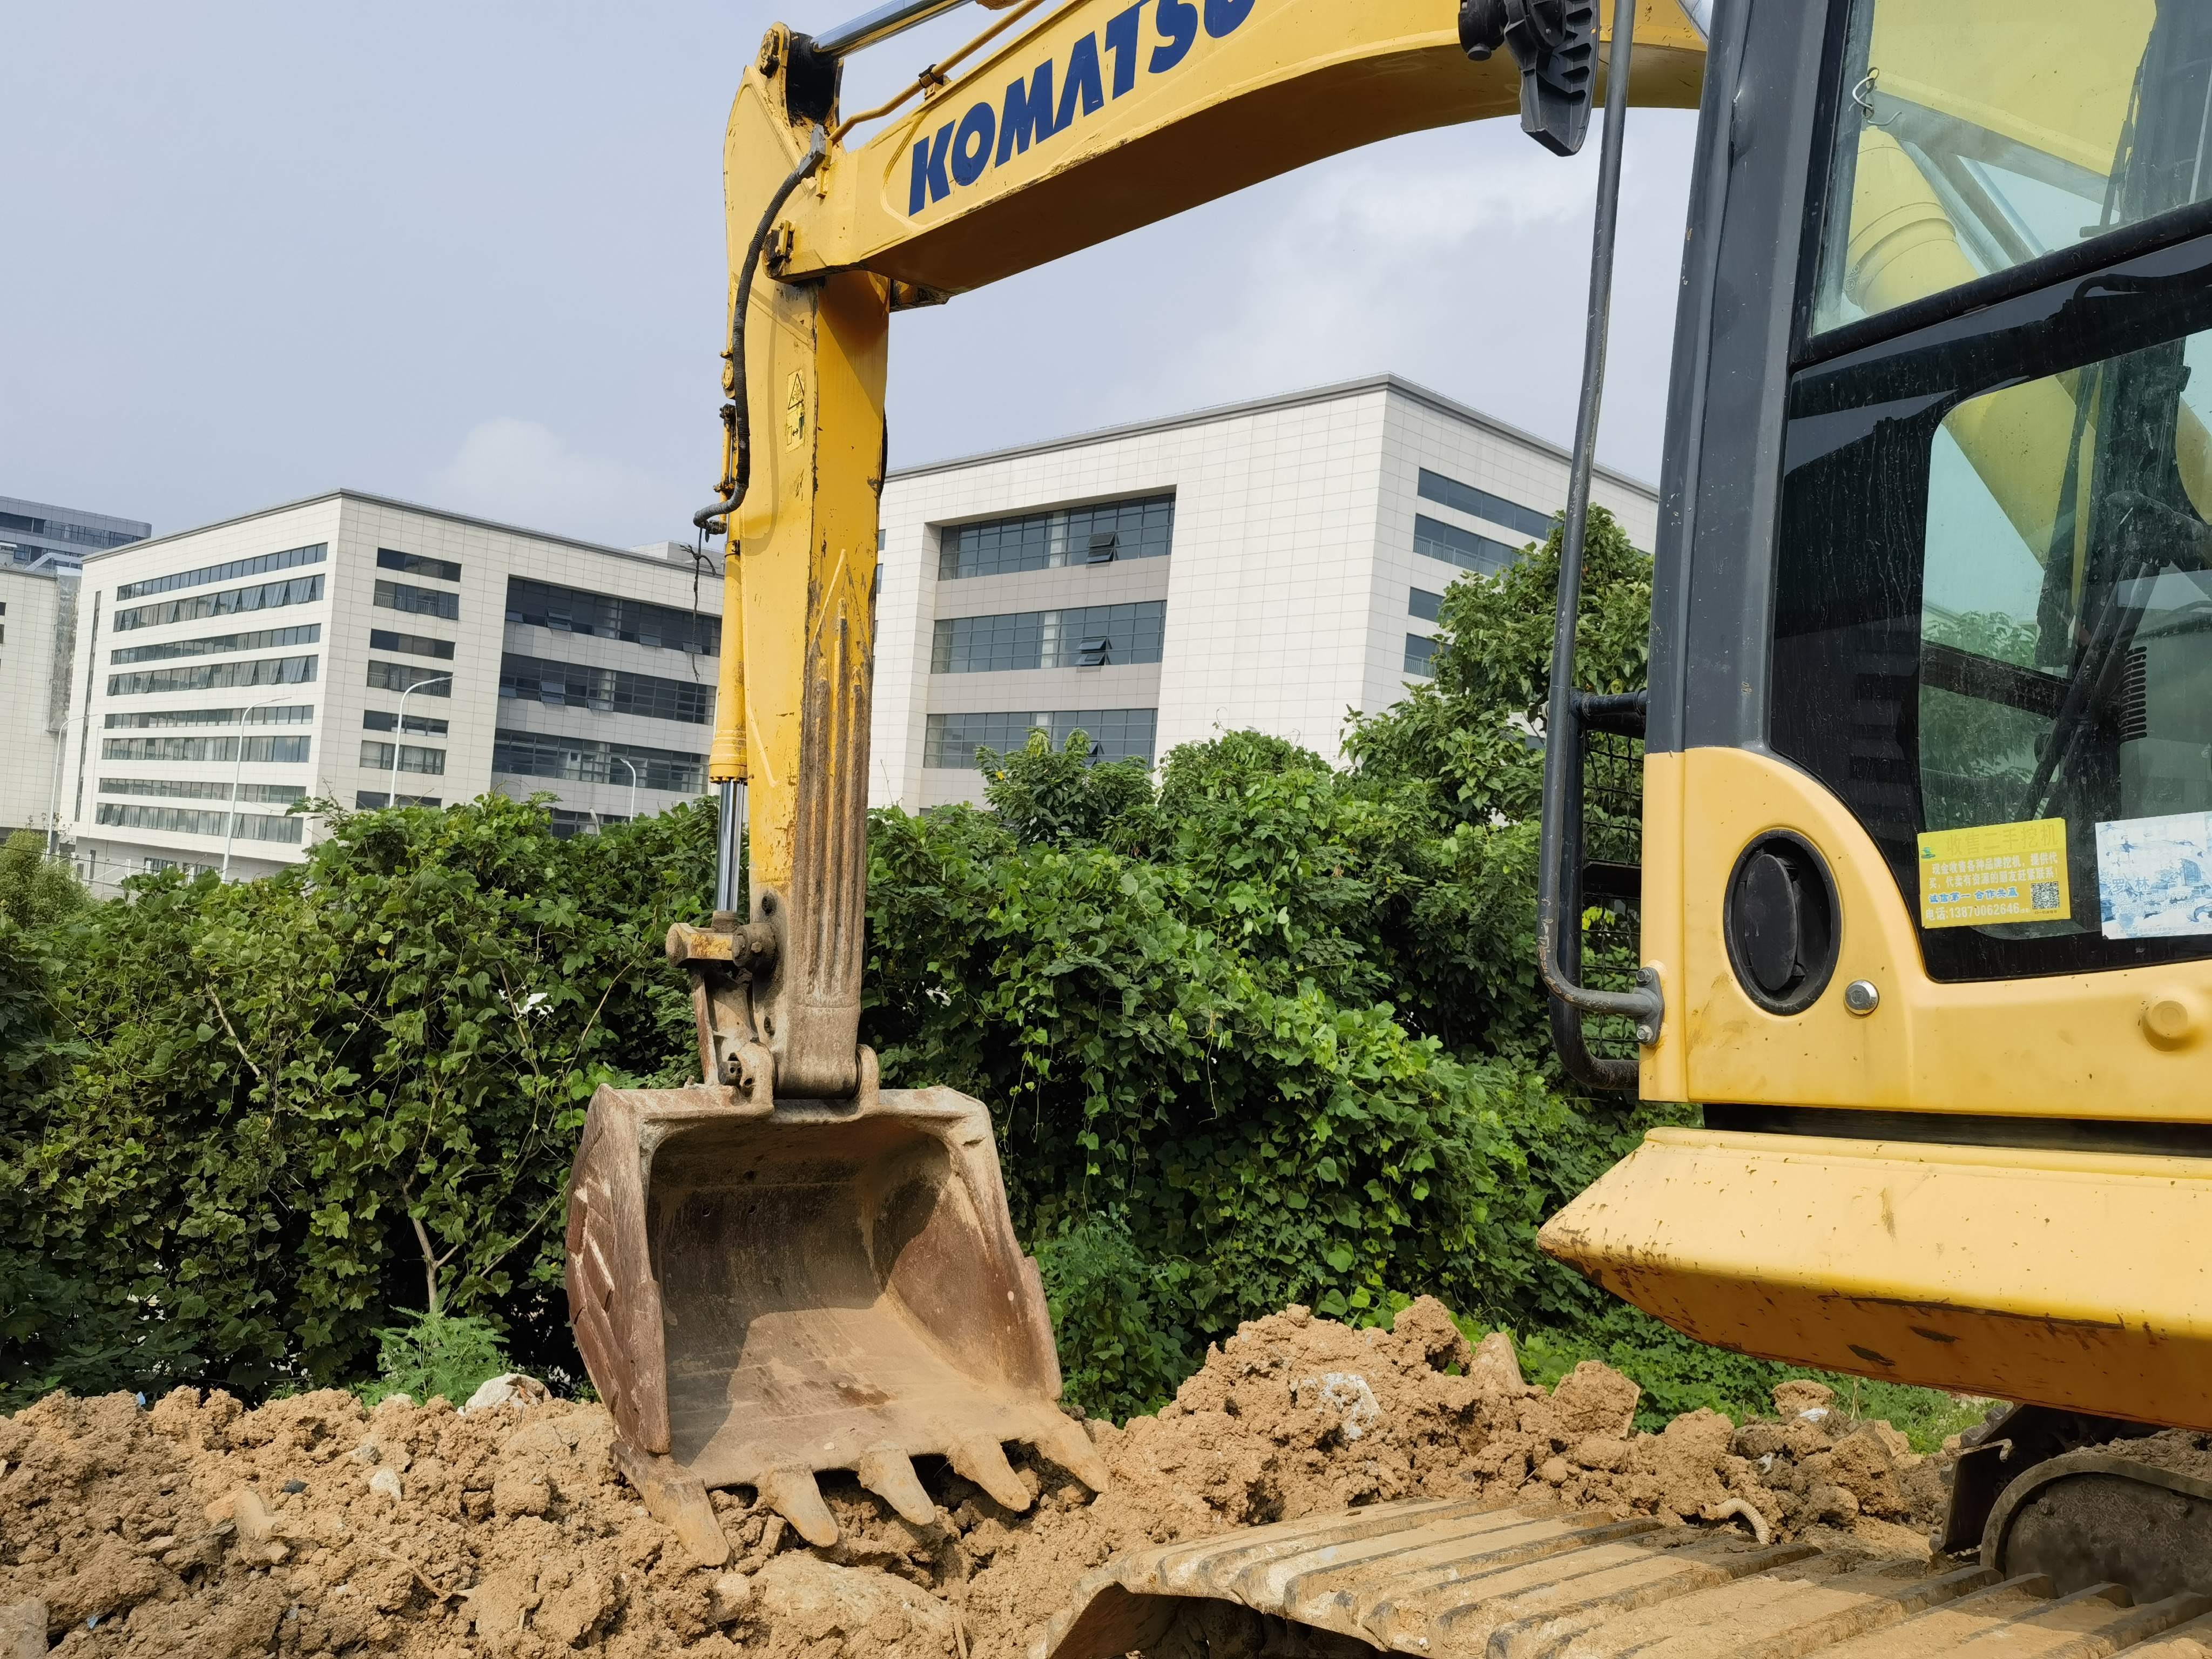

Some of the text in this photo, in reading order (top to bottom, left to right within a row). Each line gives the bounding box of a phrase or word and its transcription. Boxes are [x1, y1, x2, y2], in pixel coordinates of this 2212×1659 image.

[1946, 824, 2058, 857] 收售二手挖机
[1929, 887, 2019, 903] 诚信第一 合作共赢
